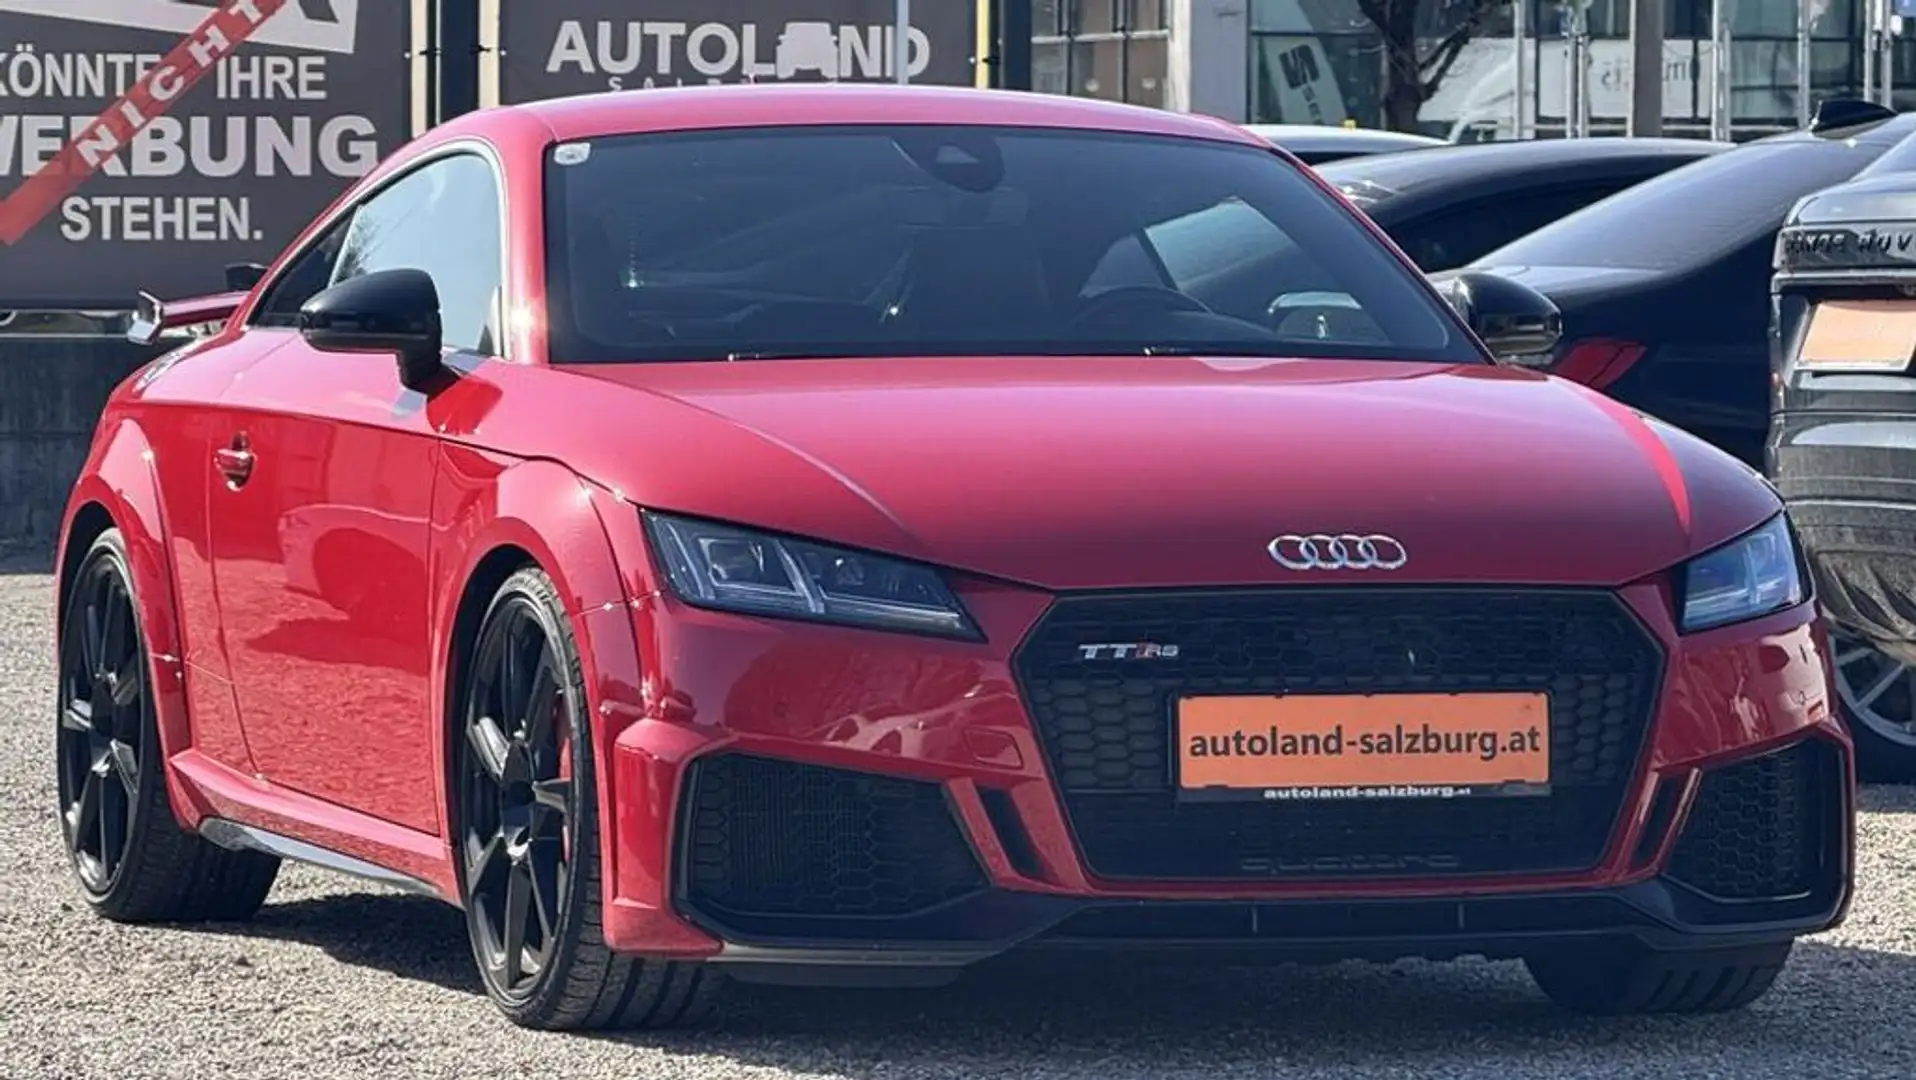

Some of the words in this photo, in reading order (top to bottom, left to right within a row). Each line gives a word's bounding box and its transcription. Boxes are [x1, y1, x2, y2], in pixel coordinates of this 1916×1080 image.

[76, 0, 263, 167] NICHT
[216, 55, 328, 100] IHRE
[60, 196, 263, 242] STEHEN.
[1189, 724, 1541, 762] autoland-salzburg.at
[1263, 784, 1472, 800] autoland-salzburg.at
